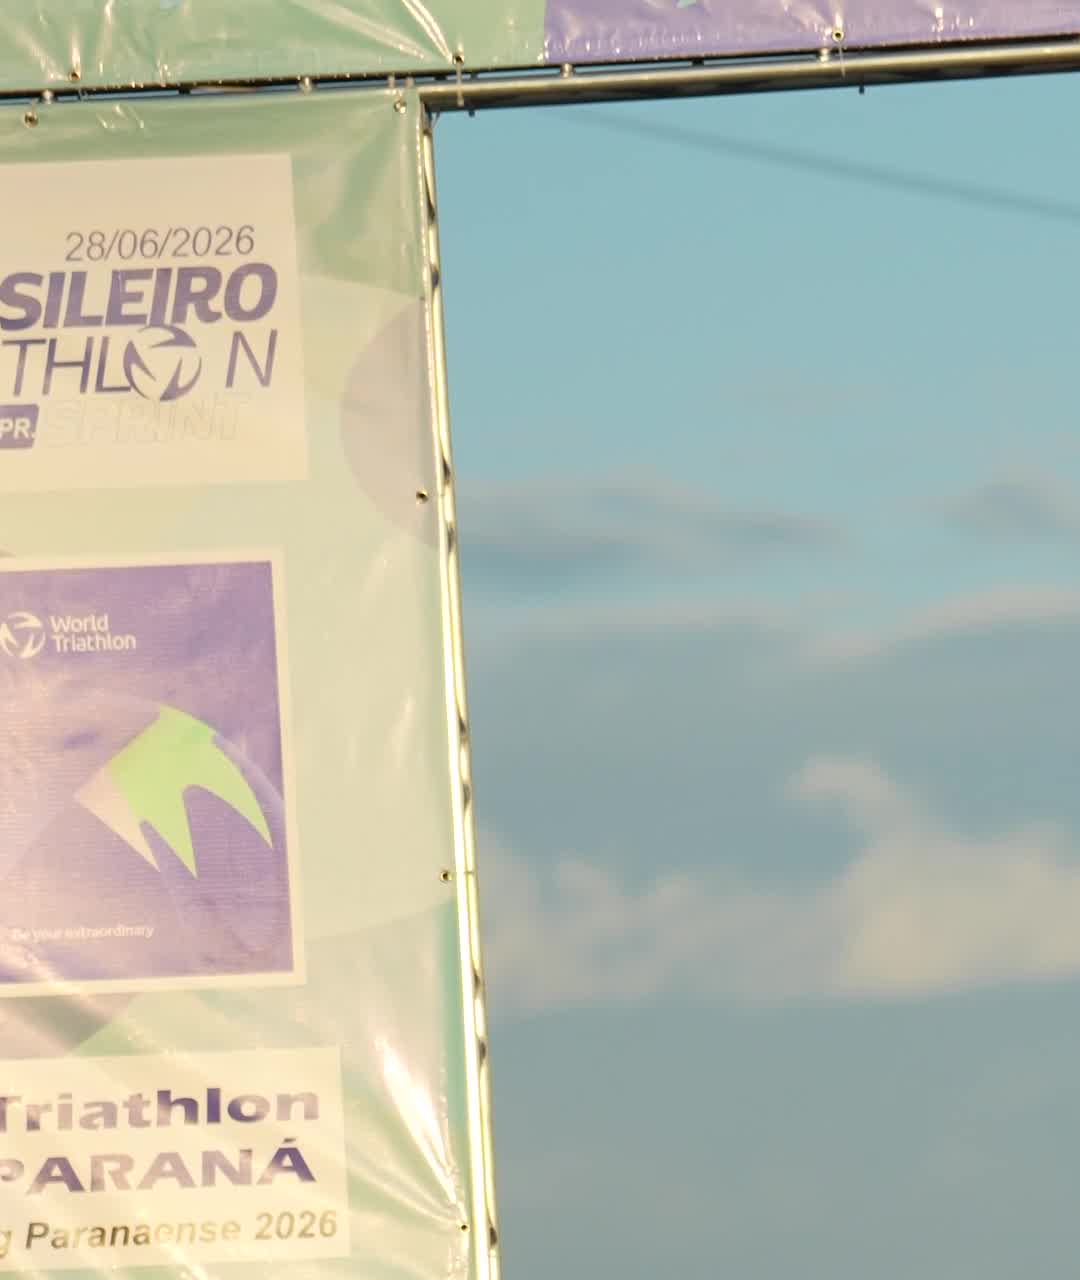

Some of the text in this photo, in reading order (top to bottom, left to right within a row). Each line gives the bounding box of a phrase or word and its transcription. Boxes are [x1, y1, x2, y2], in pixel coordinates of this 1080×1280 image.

[65, 225, 256, 262] 28/06/2026
[0, 262, 279, 331] SILEIRO
[50, 613, 109, 633] World
[52, 631, 137, 653] Triathlon
[26, 1217, 242, 1250] Paranaense
[254, 1209, 338, 1241] 2026
